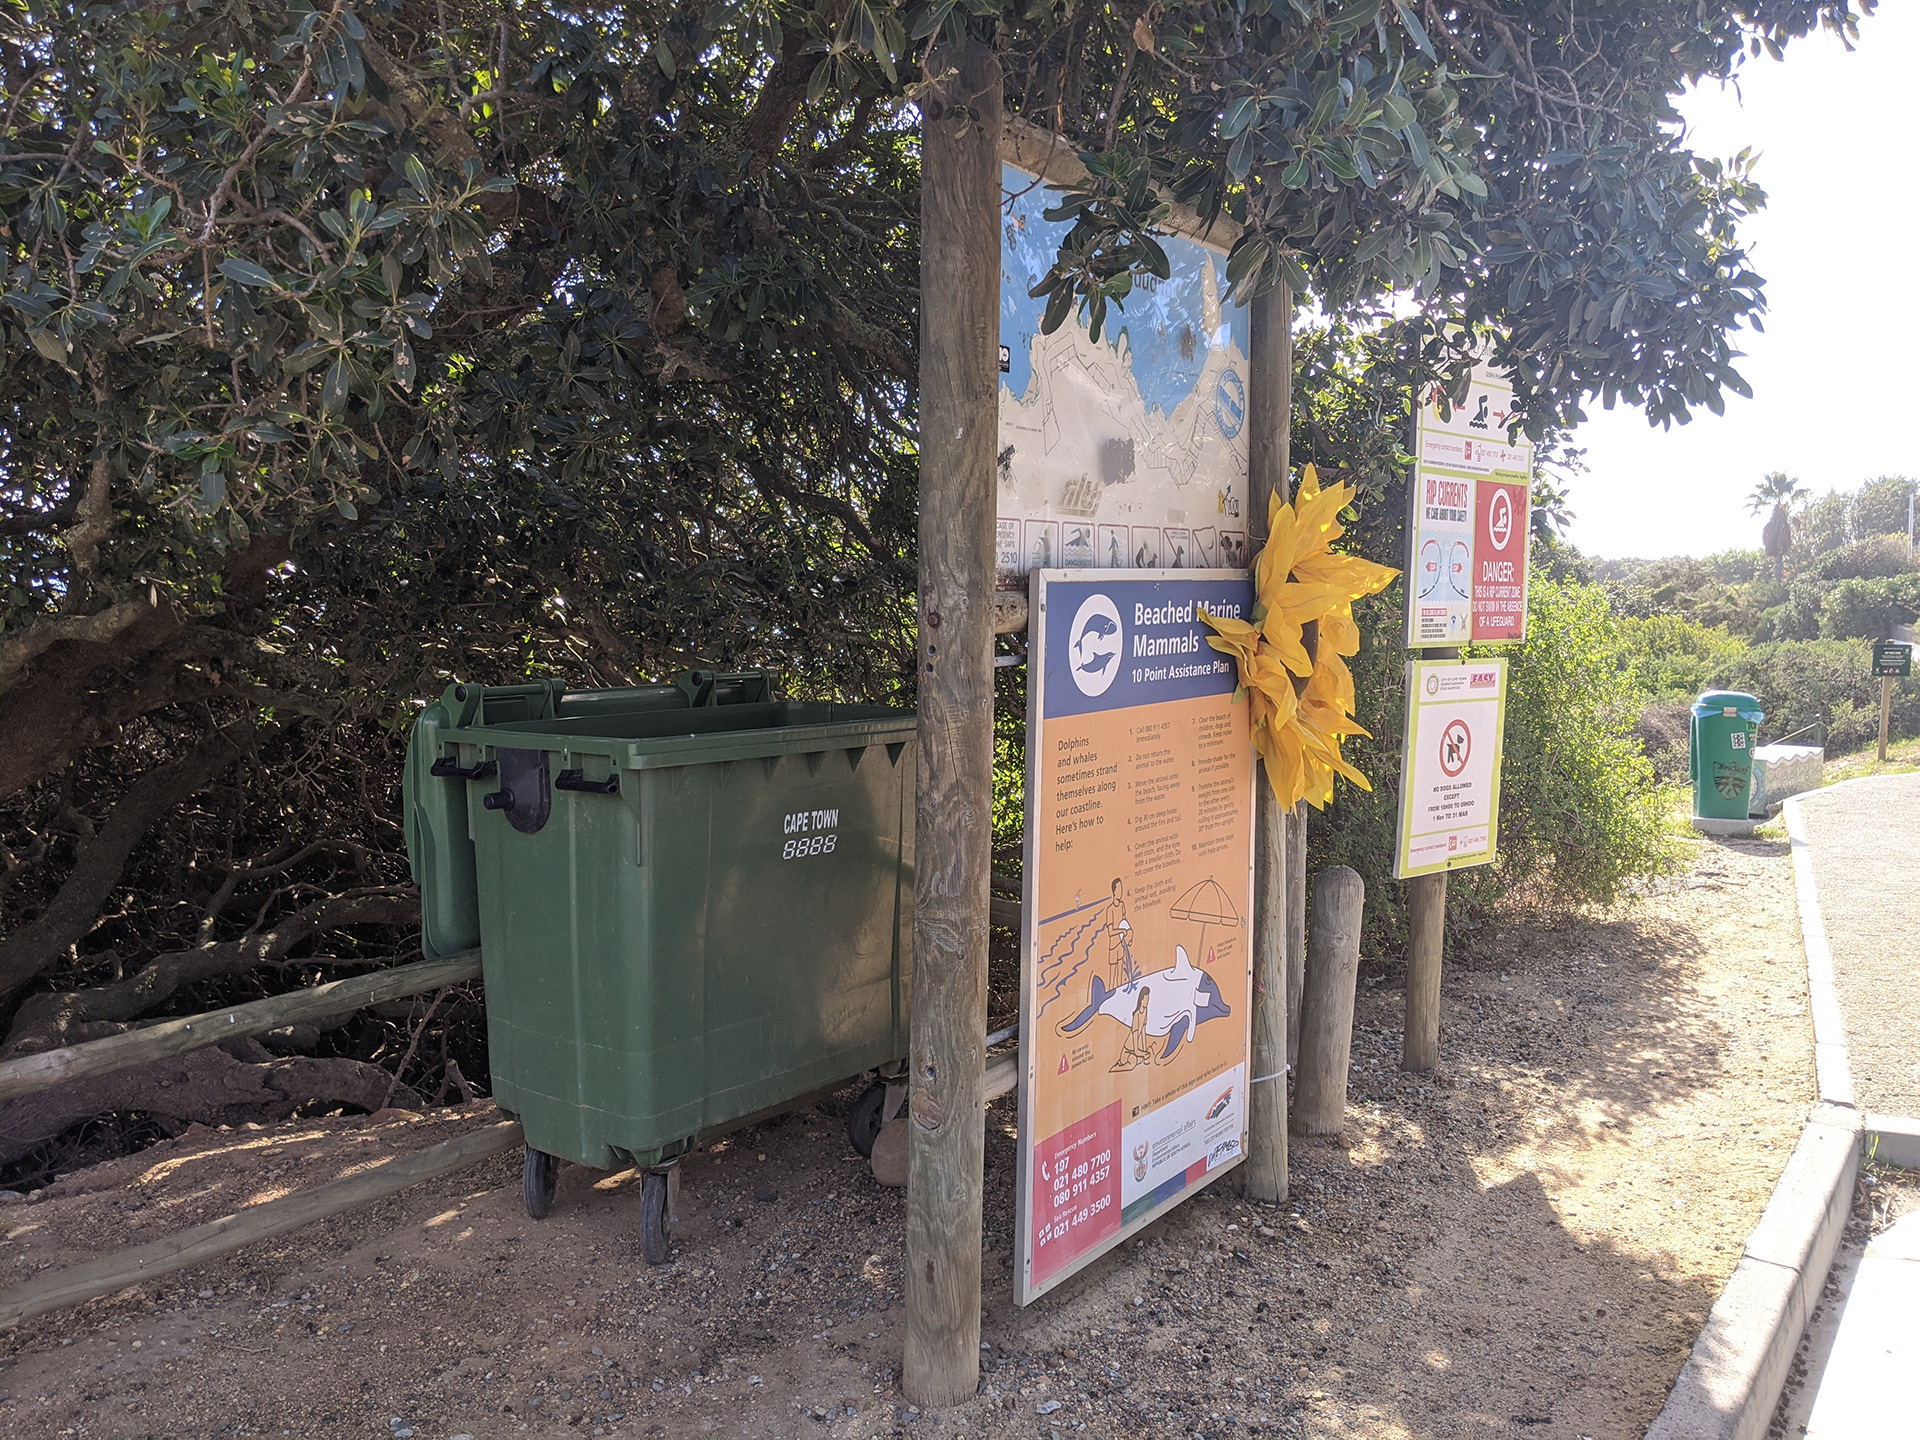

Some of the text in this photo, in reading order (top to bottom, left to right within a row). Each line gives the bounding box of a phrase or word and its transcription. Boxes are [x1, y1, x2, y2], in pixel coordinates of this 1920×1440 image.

[1426, 479, 1468, 508] RIP CURRENTS
[1001, 552, 1017, 564] 2510
[1483, 561, 1514, 582] DANGER:
[1496, 586, 1511, 598] CURRENT
[1135, 599, 1240, 626] Beached Marine
[1473, 601, 1477, 612] DO
[1486, 601, 1495, 612] SWIM
[1496, 601, 1499, 612] IN
[1507, 601, 1522, 612] ABSENCE
[1479, 616, 1486, 627] OF
[1133, 630, 1199, 657] Mammals
[1132, 660, 1229, 683] 10 Point Assistance Plan
[1058, 737, 1089, 752] Dolphins
[1058, 752, 1097, 768] and whales
[1057, 763, 1118, 784] sometimes strand
[1056, 780, 1116, 801] themselves along
[1056, 800, 1102, 818] our coastline.
[784, 809, 838, 834] CAPE TOWN
[1056, 815, 1104, 835] Here's how to
[1135, 823, 1150, 832] around
[782, 834, 837, 860] 8888
[1056, 840, 1073, 852] help:
[1152, 1097, 1161, 1105] Take
[1165, 1089, 1176, 1099] photo
[1054, 1132, 1096, 1160] Emergency Numbers
[1053, 1149, 1111, 1191] 021 480 7700
[1054, 1156, 1070, 1174] 107
[1053, 1165, 1110, 1208] 080 911 4357
[1053, 1194, 1111, 1238] 021 449 3500
[1062, 1205, 1078, 1219] Rescue
